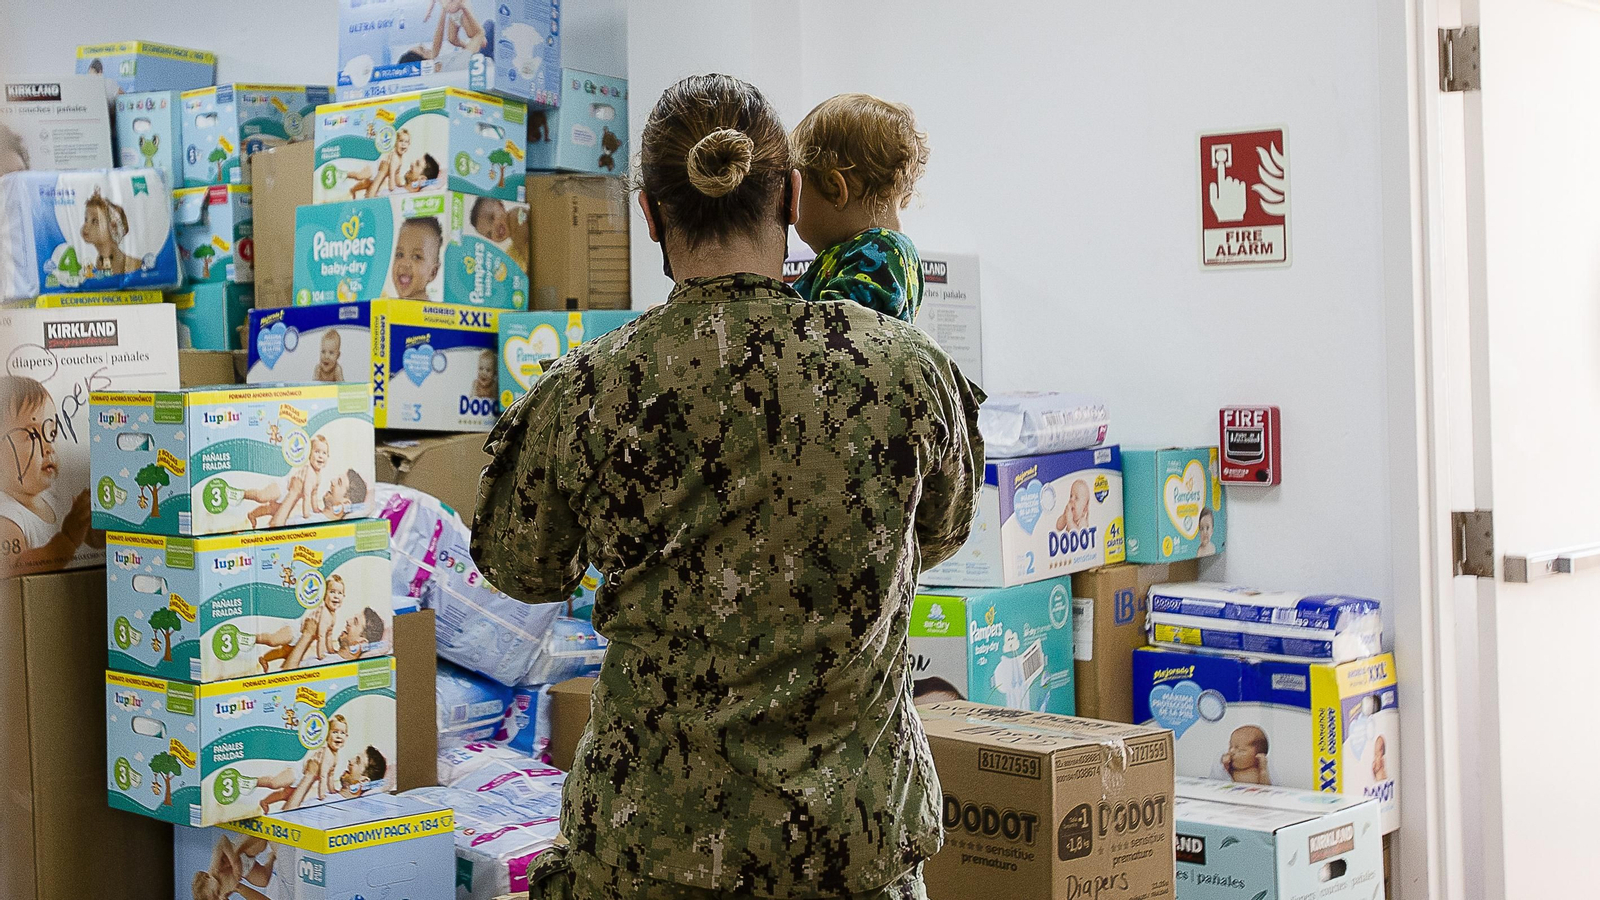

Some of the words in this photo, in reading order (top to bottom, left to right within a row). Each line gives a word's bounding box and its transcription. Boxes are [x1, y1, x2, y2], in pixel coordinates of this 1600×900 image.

[349, 21, 375, 33] ULTRA
[472, 53, 485, 75] 3
[8, 84, 60, 97] KIRKLAND
[325, 170, 334, 185] 3
[1226, 230, 1262, 243] FIRE
[313, 231, 375, 261] Pampers
[1216, 242, 1273, 257] ALARM
[58, 246, 82, 277] 4
[321, 261, 366, 276] baby-dry
[469, 242, 485, 304] Pampers
[423, 306, 455, 316] AHORRO
[460, 310, 492, 328] XXL
[48, 322, 116, 339] KIRKLAND
[12, 357, 53, 371] diapers
[60, 354, 103, 366] couches
[111, 352, 150, 365] pañales
[373, 362, 385, 407] XXL
[99, 412, 128, 425] lupilu
[204, 411, 240, 425] lupilu
[412, 404, 422, 422] 3
[1224, 410, 1264, 427] FIRE
[7, 367, 112, 485] Diapers
[202, 452, 231, 462] PAÑALES
[202, 461, 231, 471] FRALDAS
[103, 486, 111, 502] 3
[211, 487, 222, 507] 3
[1174, 487, 1200, 503] Pampers
[1049, 526, 1097, 558] DODOT
[115, 551, 141, 566] lupilu
[214, 556, 252, 570] lupilu
[1026, 550, 1035, 575] 2
[212, 598, 242, 609] PAÑALES
[212, 608, 242, 618] FRALDAS
[119, 625, 127, 643] 3
[970, 620, 1003, 645] Pampers
[221, 633, 233, 653] 3
[1368, 662, 1387, 682] XXL
[215, 699, 254, 714] lupilu
[1327, 707, 1337, 755] AHORRO
[213, 742, 244, 753] PAÑALES
[213, 751, 244, 762] FRALDAS
[982, 752, 1036, 775] 81727559
[119, 766, 127, 783] 3
[222, 778, 234, 797] 3
[943, 793, 1037, 843] DODOT
[1081, 808, 1088, 829] 1
[1099, 797, 1166, 837] DODOT
[239, 819, 263, 833] PACK
[271, 824, 289, 839] 184
[328, 828, 383, 848] ECONOMY
[384, 823, 411, 838] PACK
[420, 818, 439, 831] 184
[1130, 833, 1165, 848] sensitive
[1310, 825, 1354, 853] KIRKLAND
[961, 852, 1018, 872] prematuro
[985, 844, 1035, 862] sensitive
[1112, 849, 1153, 869] prematuro
[298, 860, 314, 881] 3
[1066, 872, 1129, 900] Diapers
[1196, 872, 1246, 890] pañales
